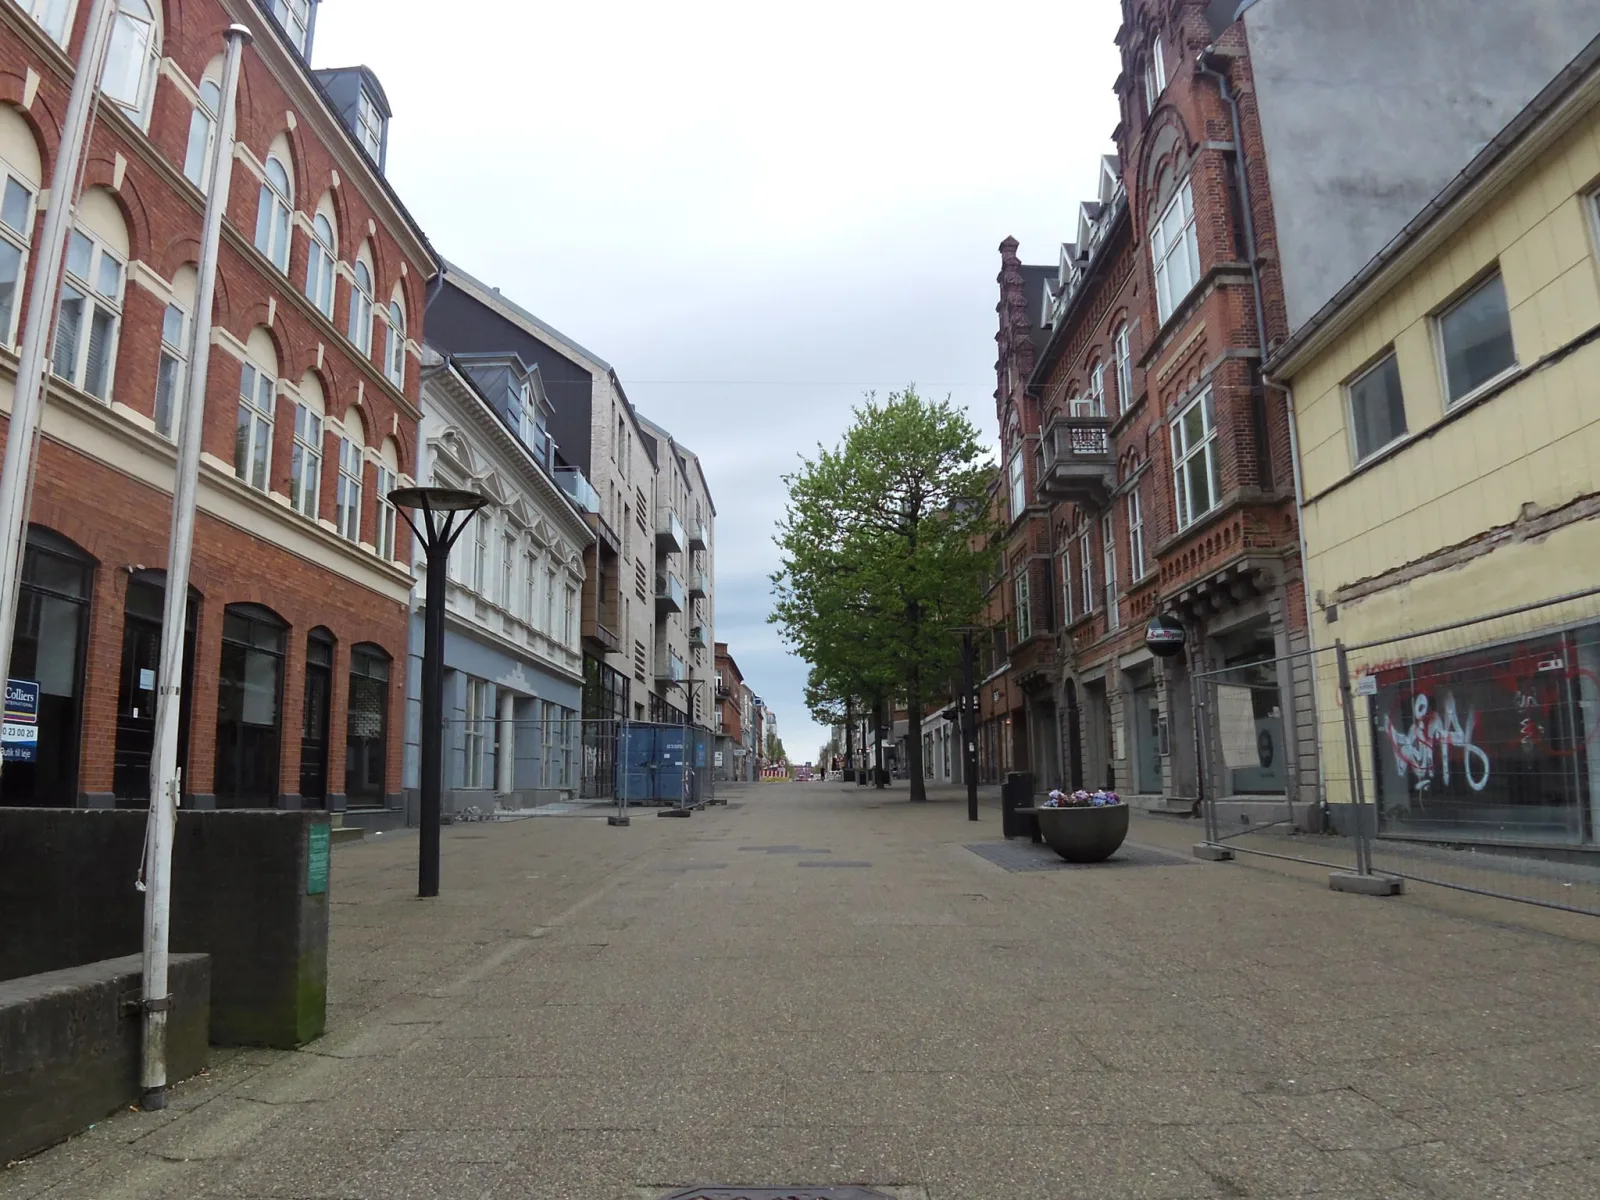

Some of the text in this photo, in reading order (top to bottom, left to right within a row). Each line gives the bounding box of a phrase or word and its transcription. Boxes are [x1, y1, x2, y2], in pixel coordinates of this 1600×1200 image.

[5, 687, 34, 702] Colliers
[8, 728, 16, 736] 23
[17, 729, 25, 737] 00
[26, 730, 34, 738] 20
